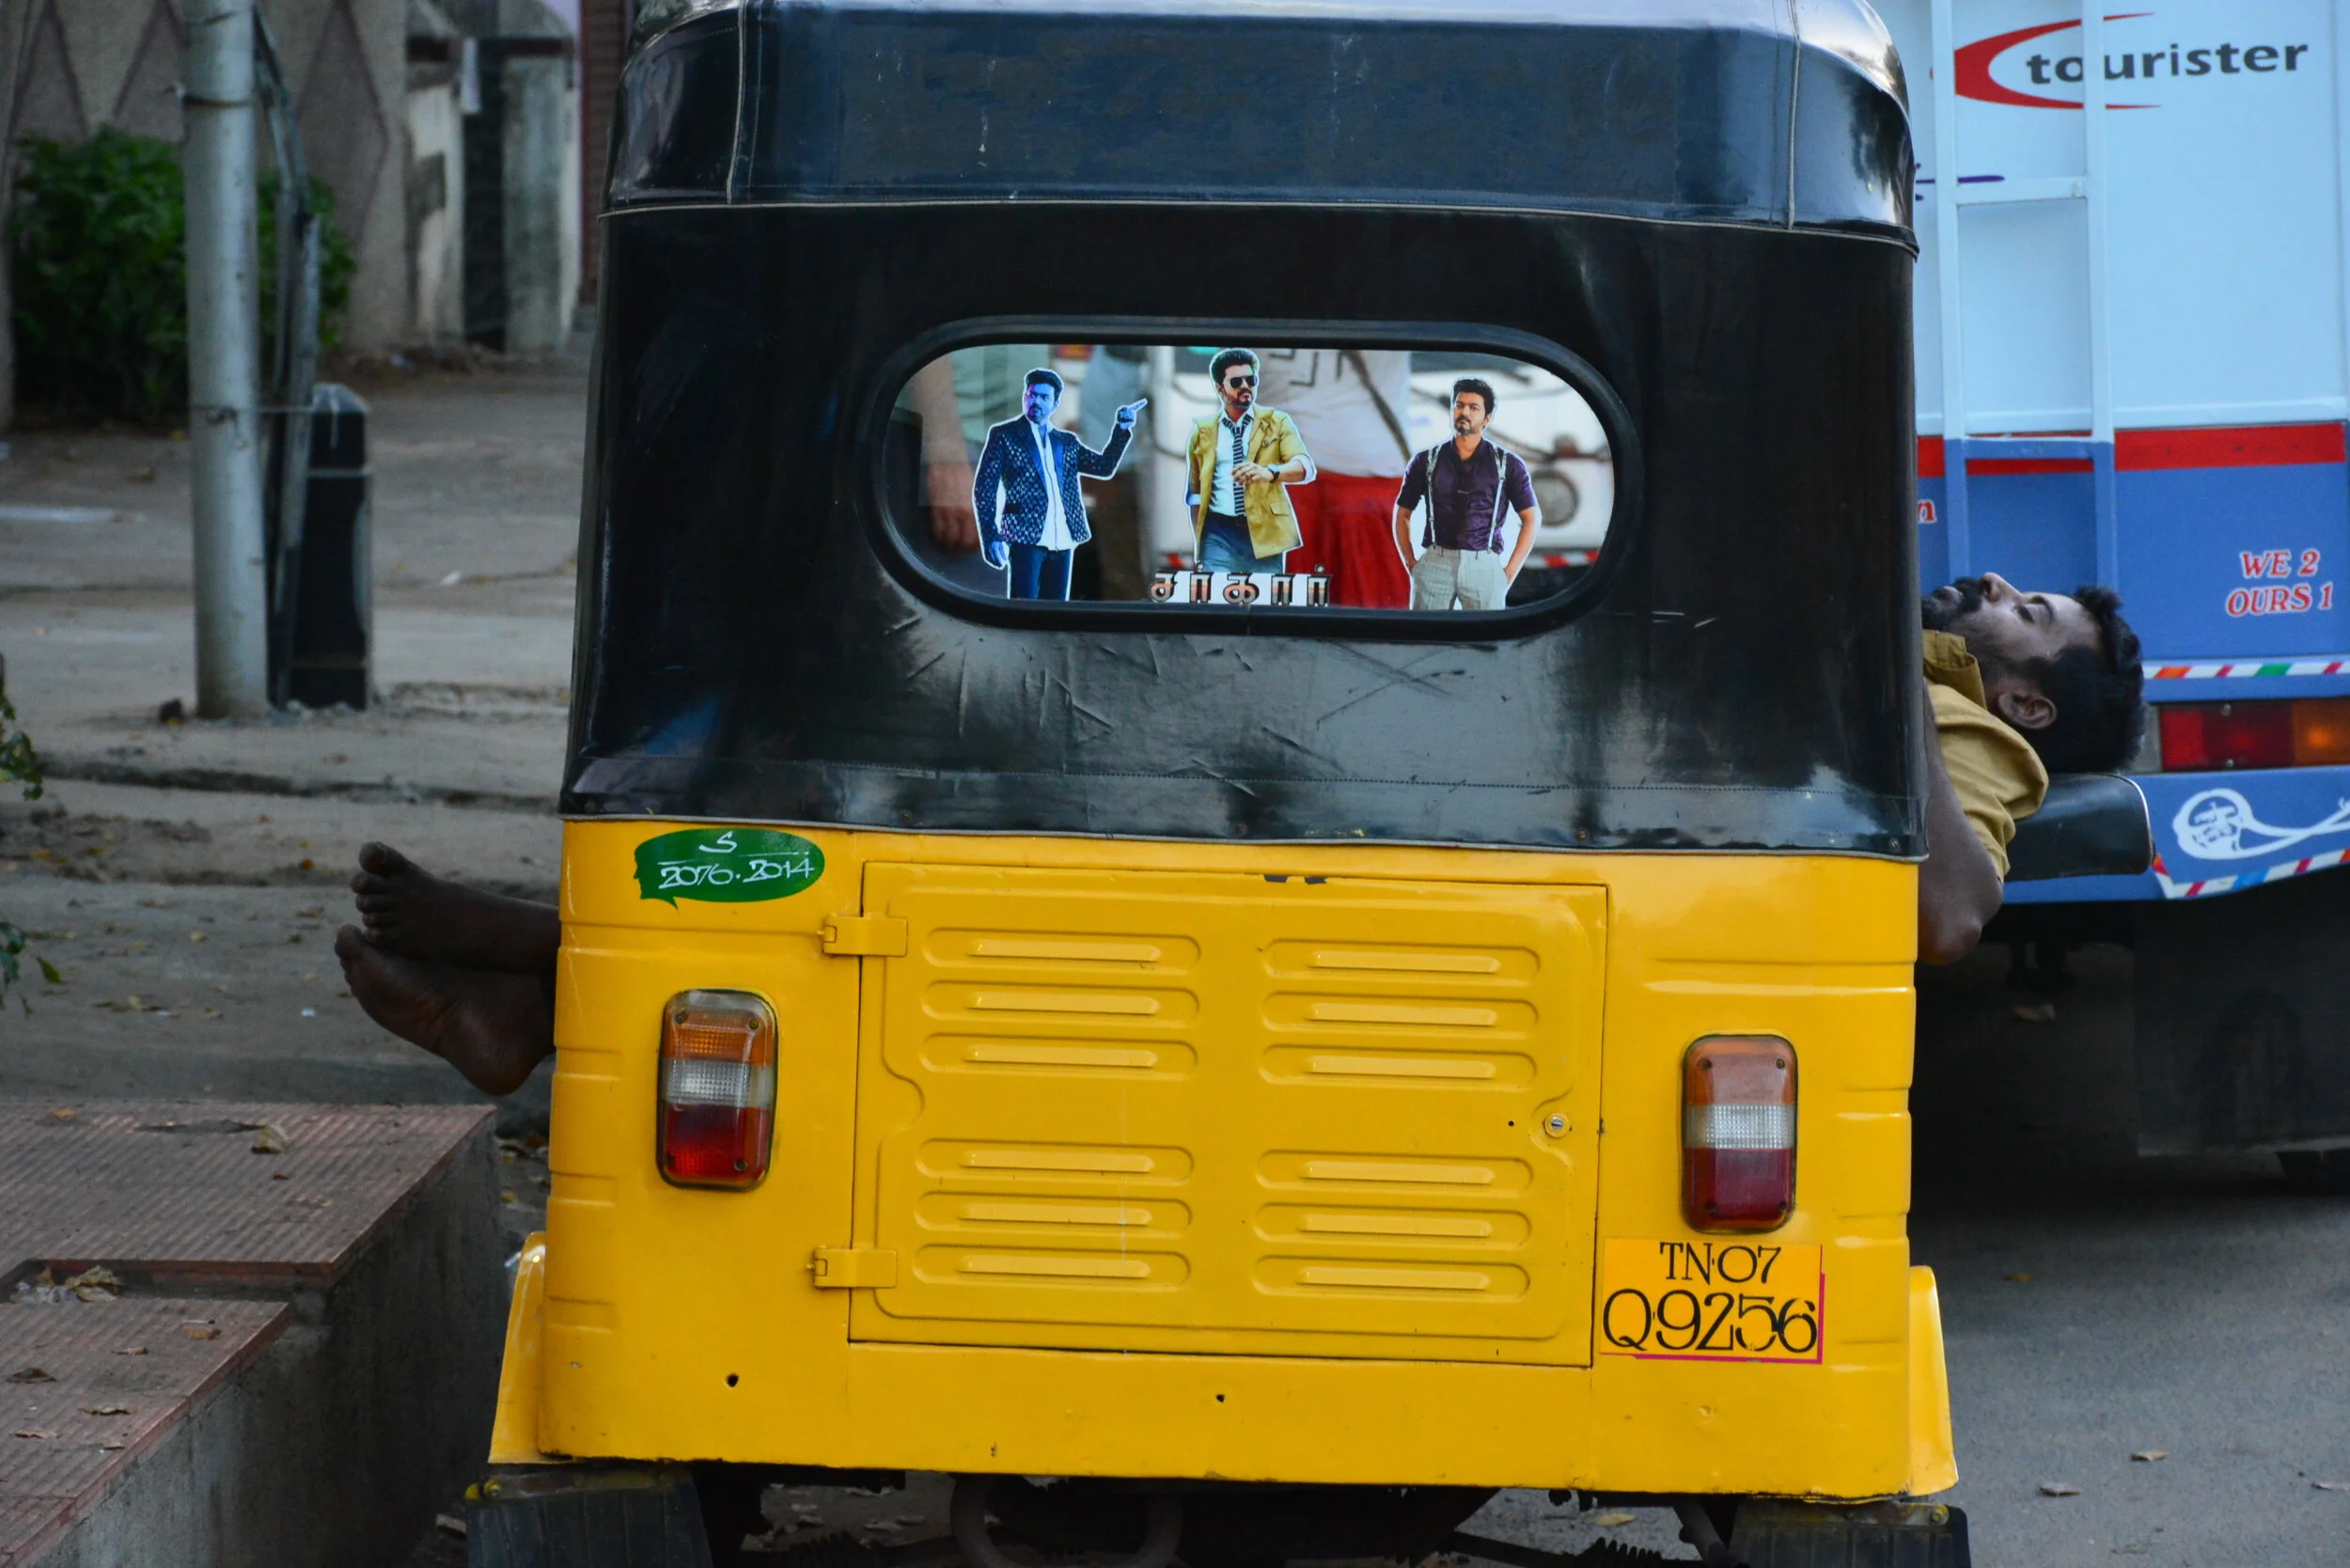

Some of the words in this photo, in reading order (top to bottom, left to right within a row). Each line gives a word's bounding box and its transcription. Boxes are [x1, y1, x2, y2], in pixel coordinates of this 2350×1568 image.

[2027, 42, 2309, 85] tourister
[2240, 549, 2292, 579] WE
[2297, 548, 2320, 577] 2
[2226, 582, 2312, 618] OURS
[2318, 581, 2333, 610] 1
